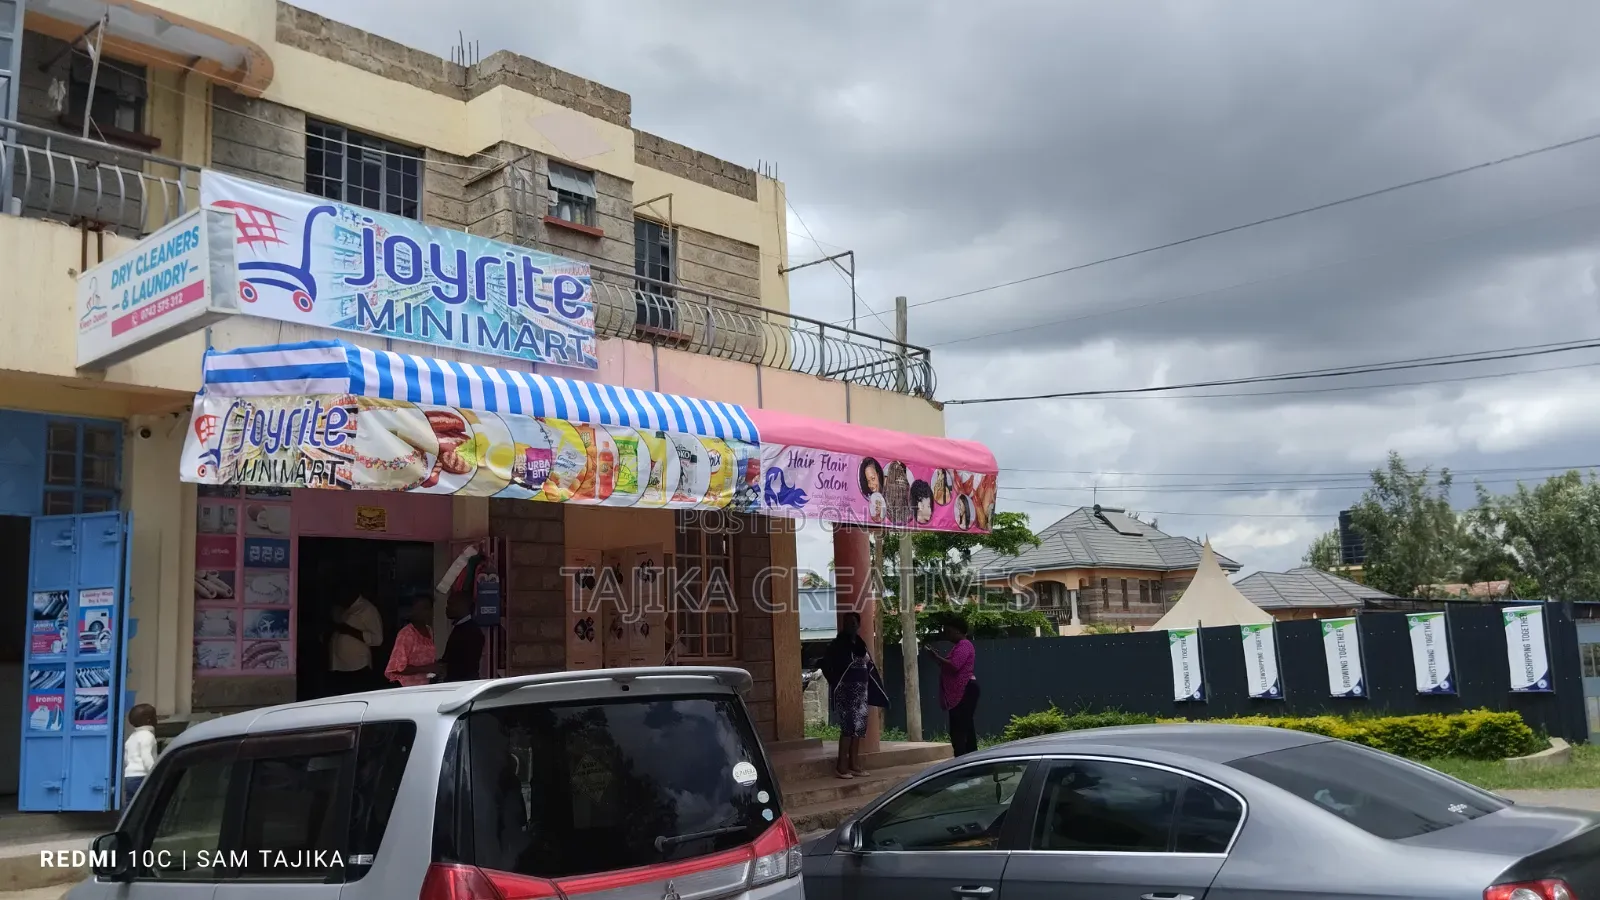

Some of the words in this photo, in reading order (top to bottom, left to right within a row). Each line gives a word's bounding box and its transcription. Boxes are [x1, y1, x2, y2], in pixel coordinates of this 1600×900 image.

[111, 260, 133, 290] DRY
[135, 226, 199, 276] CLEANERS
[344, 217, 586, 318] joyrite
[121, 290, 129, 310] &
[131, 259, 188, 306] LAUNDRY
[356, 293, 589, 363] MINIMART
[233, 400, 348, 454] joyrite
[233, 459, 345, 485] MINIMART
[528, 459, 550, 470] URBA
[788, 450, 815, 468] Hair
[820, 454, 848, 472] Flair
[814, 472, 848, 491] Salon
[1423, 618, 1433, 646] TOGETHER
[1520, 612, 1530, 641] TOGETHER
[1337, 628, 1347, 659] TOGETHER
[1257, 652, 1268, 690] FELLOWSHIPPING
[1341, 661, 1351, 688] GROWING
[1427, 649, 1438, 684] MINISTERING
[1523, 644, 1534, 682] WORSHIPPING
[35, 695, 62, 703] Ironing
